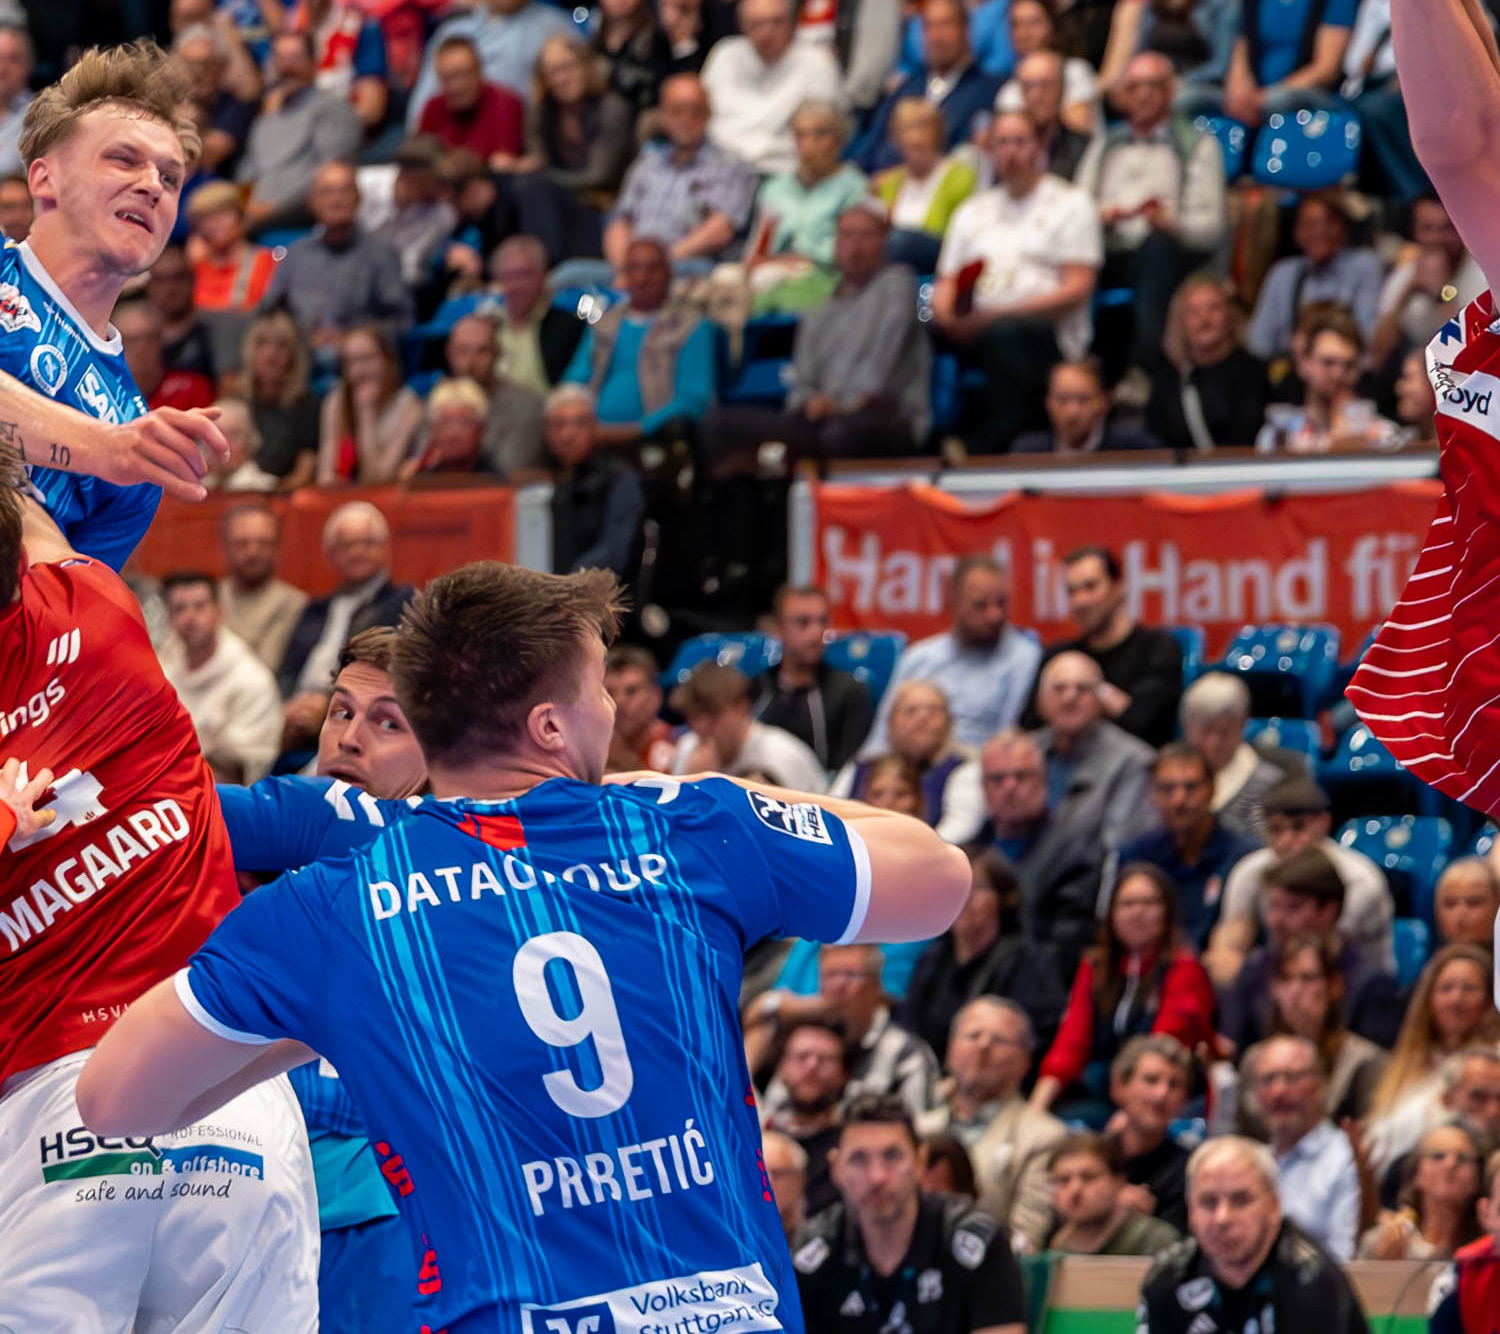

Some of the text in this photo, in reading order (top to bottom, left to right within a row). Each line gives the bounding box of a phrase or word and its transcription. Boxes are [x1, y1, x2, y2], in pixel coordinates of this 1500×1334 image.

[1125, 536, 1327, 619] Hand
[368, 852, 668, 921] DATAGOUP
[512, 929, 634, 1120] 9
[75, 1178, 233, 1203] safe and sound
[130, 1160, 154, 1176] on
[181, 1155, 261, 1179] offshore
[630, 1274, 753, 1317] Volksbank
